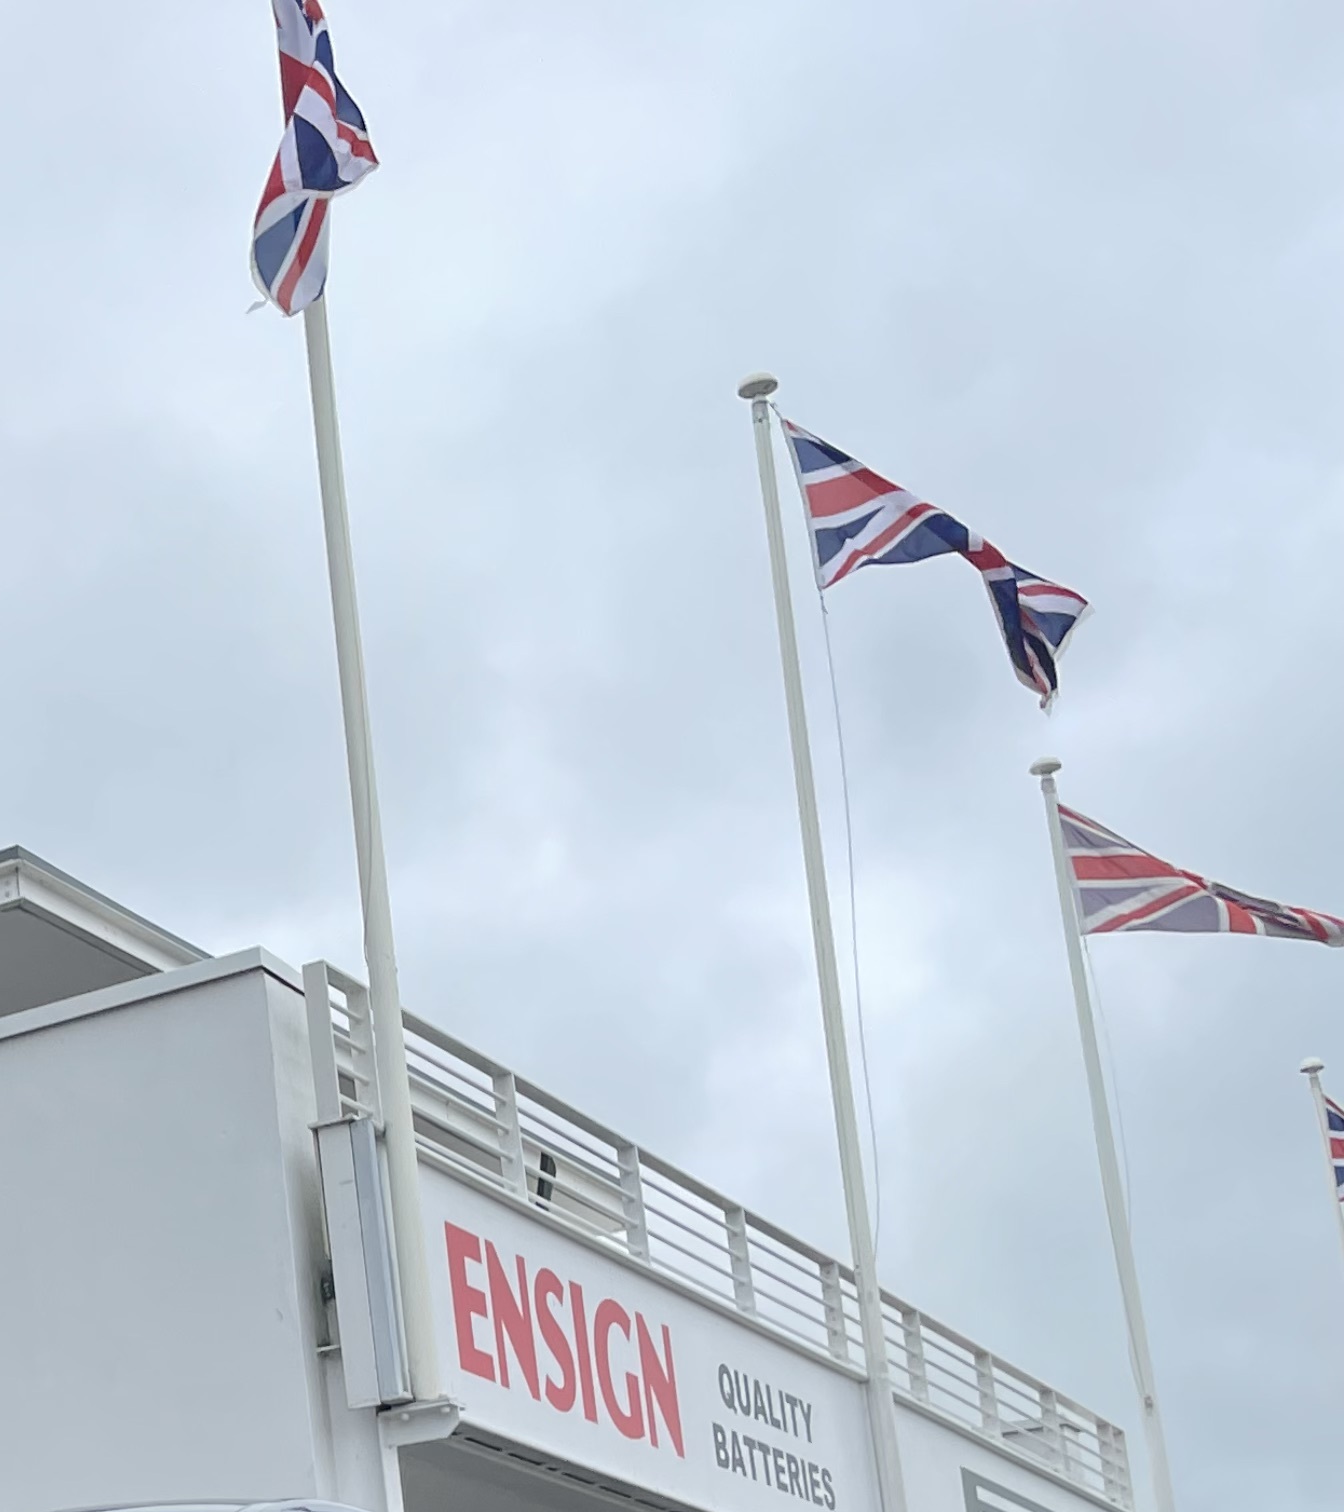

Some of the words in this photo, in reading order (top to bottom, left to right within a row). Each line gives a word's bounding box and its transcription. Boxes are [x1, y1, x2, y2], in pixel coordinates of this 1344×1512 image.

[444, 1220, 685, 1460] ENSIGN
[718, 1363, 814, 1444] QUALITY
[712, 1422, 836, 1512] BATTERIES
